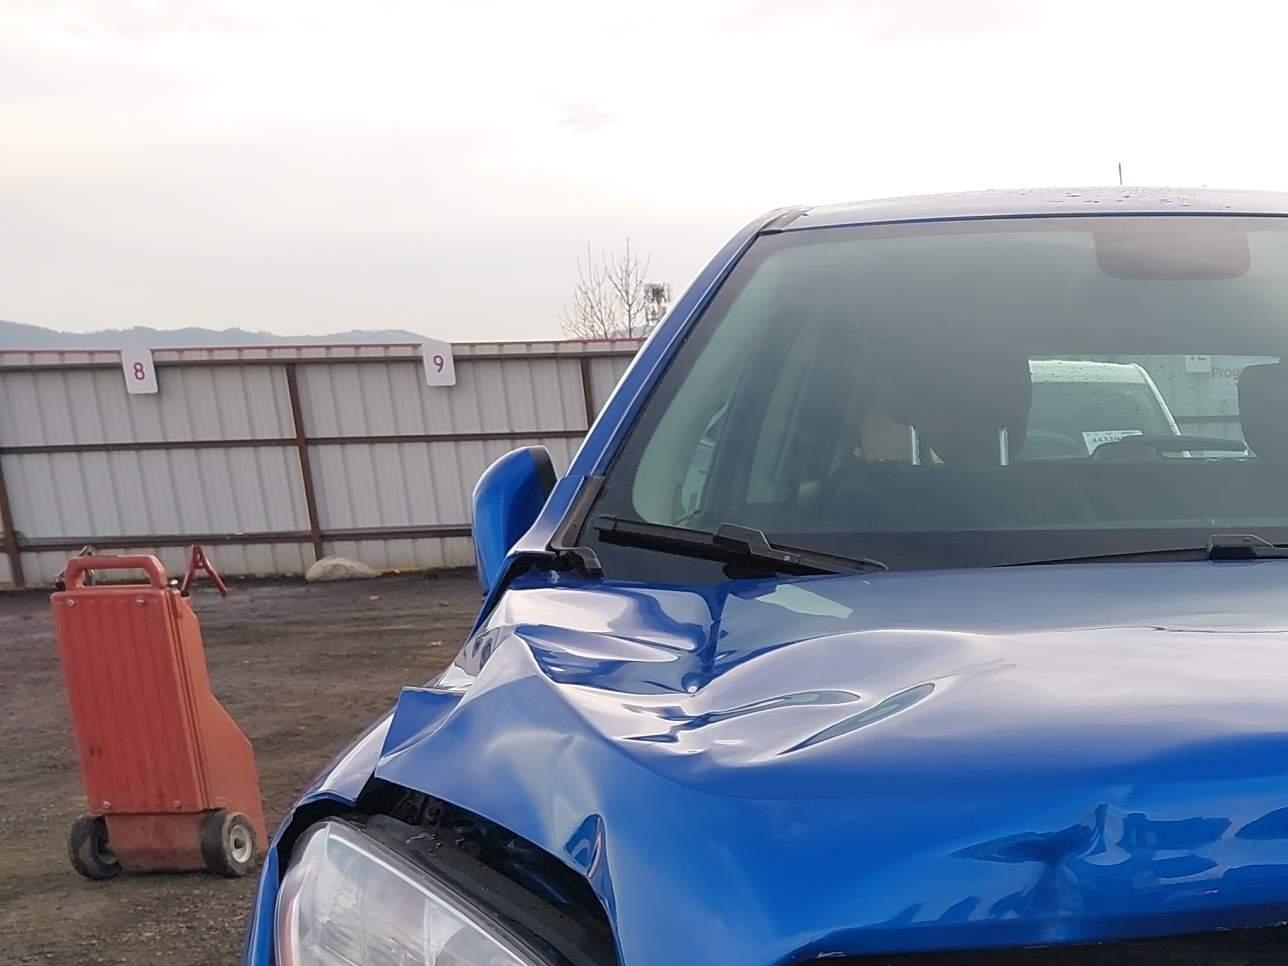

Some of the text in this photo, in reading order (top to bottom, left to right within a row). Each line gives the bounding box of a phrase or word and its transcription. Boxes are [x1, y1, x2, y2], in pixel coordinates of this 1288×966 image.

[133, 361, 145, 380] 8
[433, 354, 444, 373] 9
[1211, 367, 1244, 380] Prog
